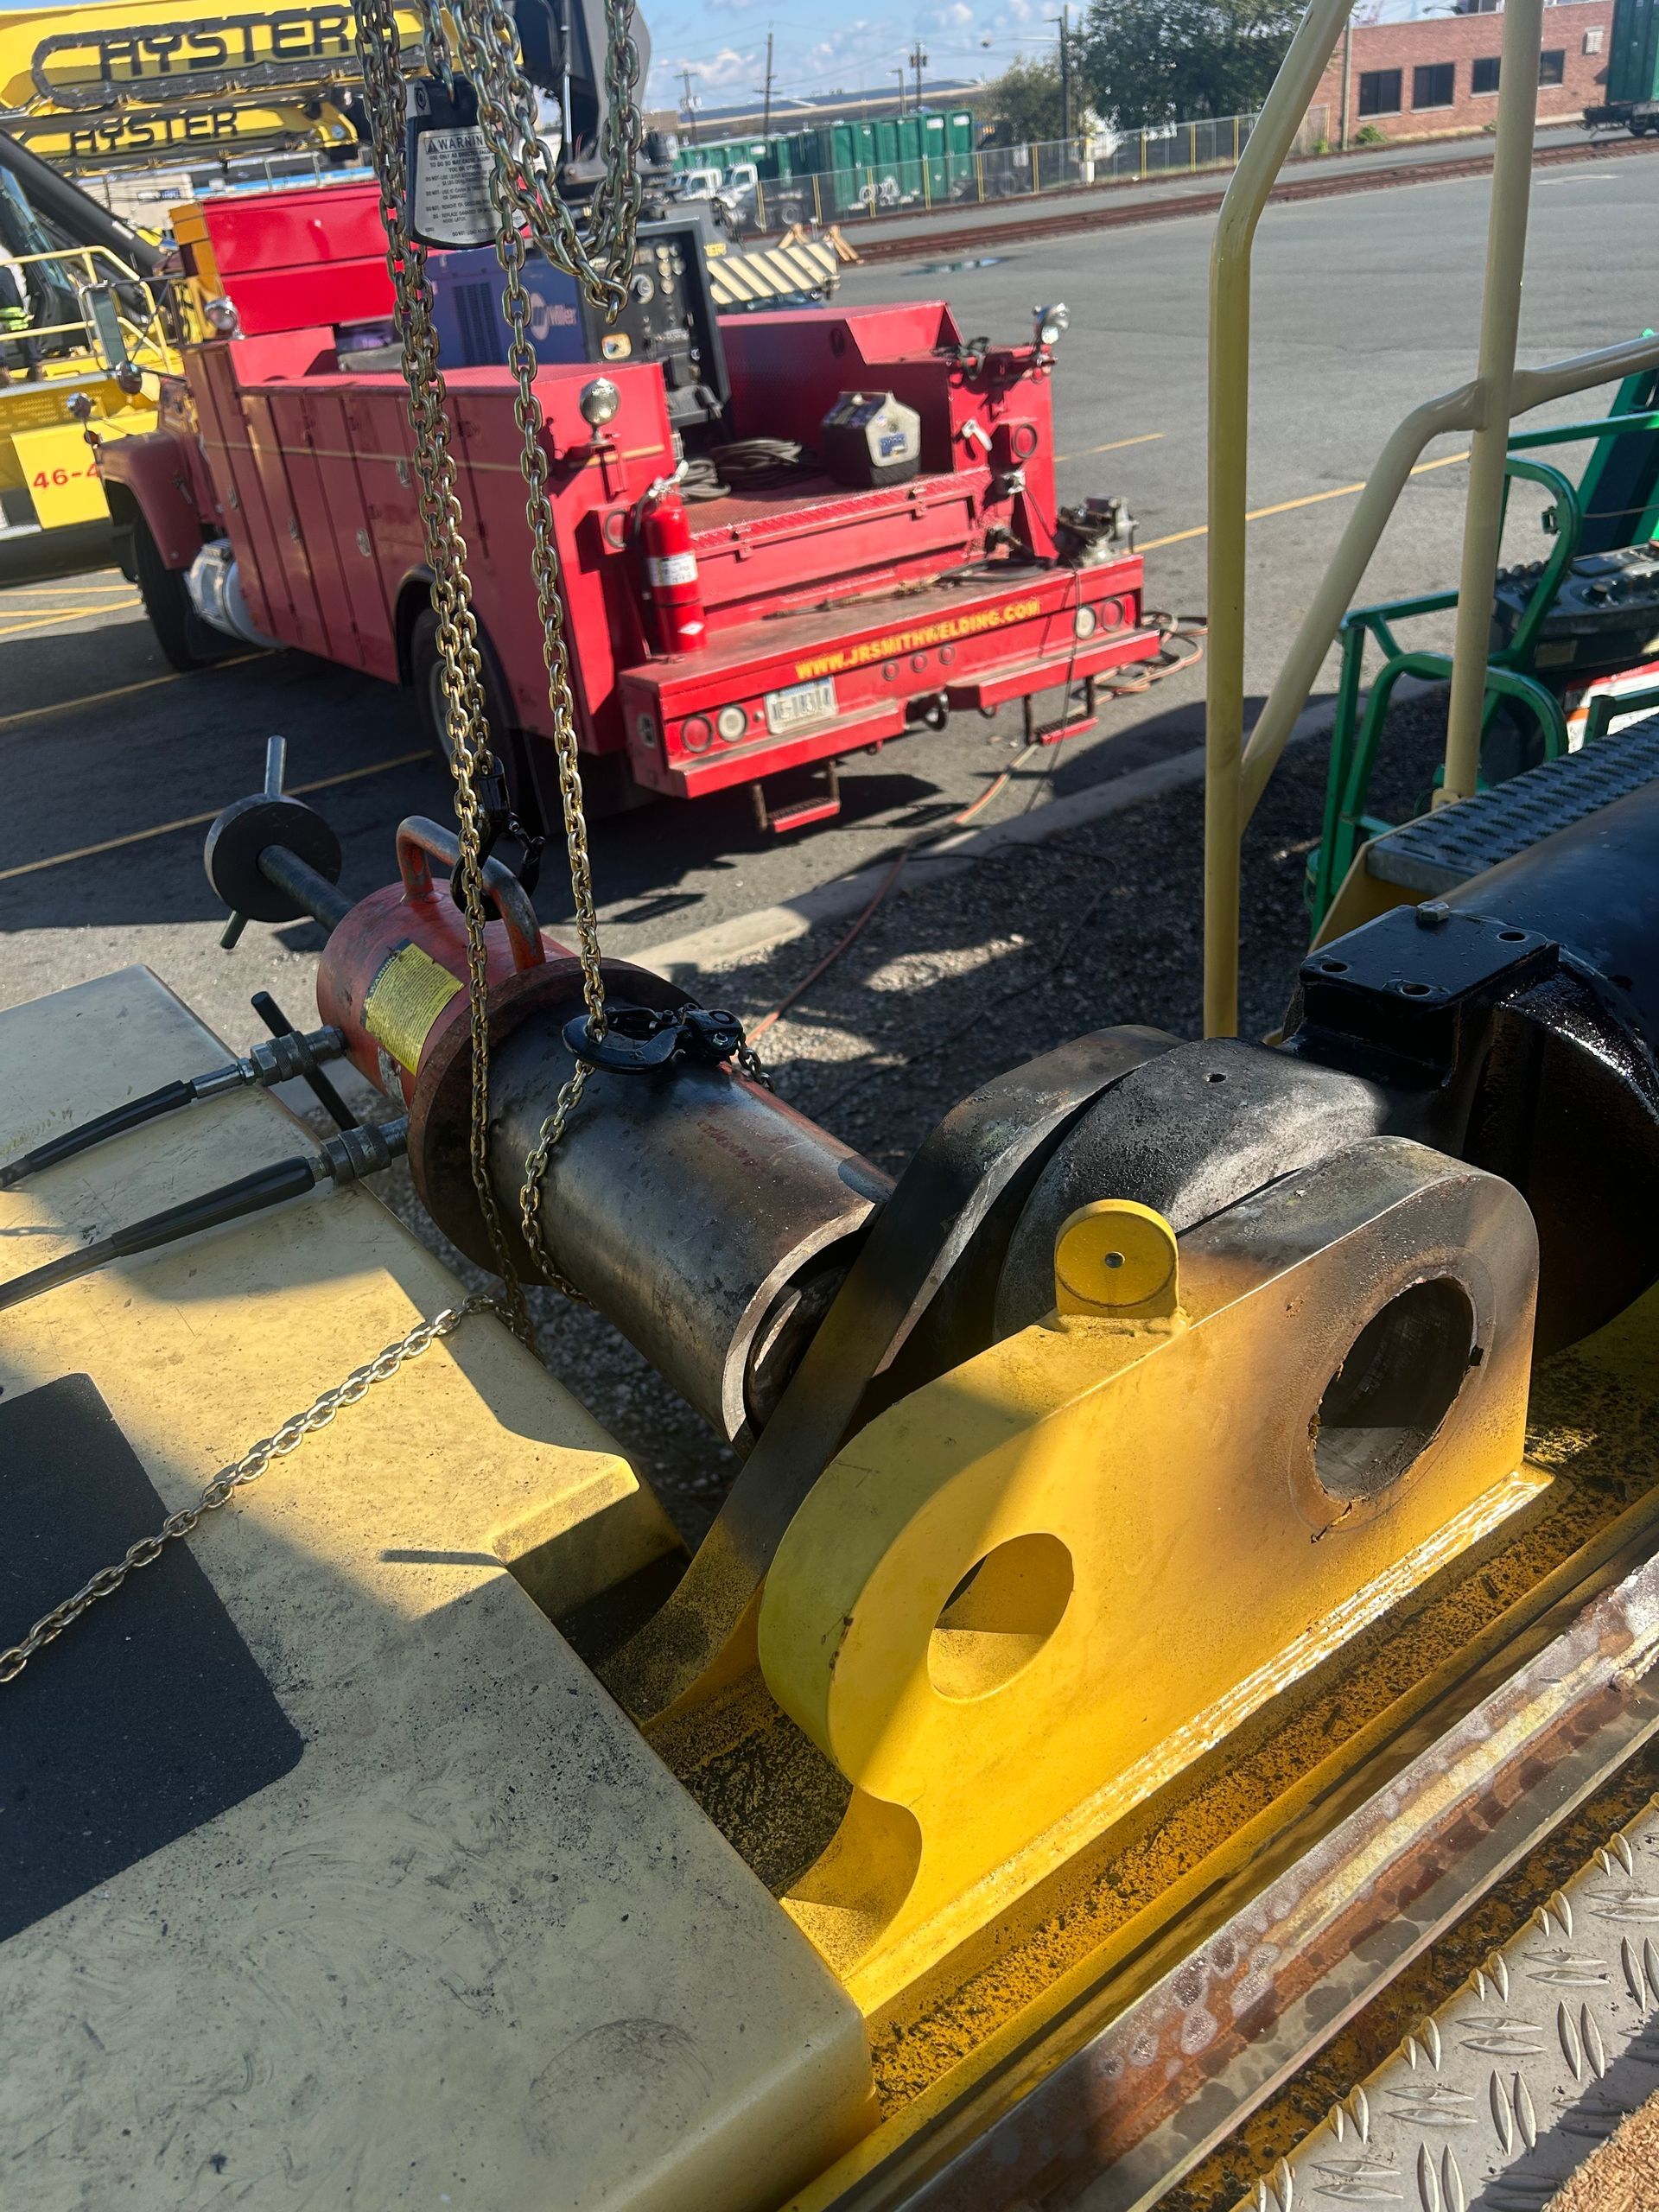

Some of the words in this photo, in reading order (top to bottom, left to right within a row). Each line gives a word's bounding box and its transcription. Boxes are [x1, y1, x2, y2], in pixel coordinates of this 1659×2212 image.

[99, 16, 350, 81] HYSTER
[70, 111, 238, 156] HYSTER
[438, 135, 484, 149] WARNIN
[795, 599, 1040, 679] WWW.JRSMITHWELDING.COM
